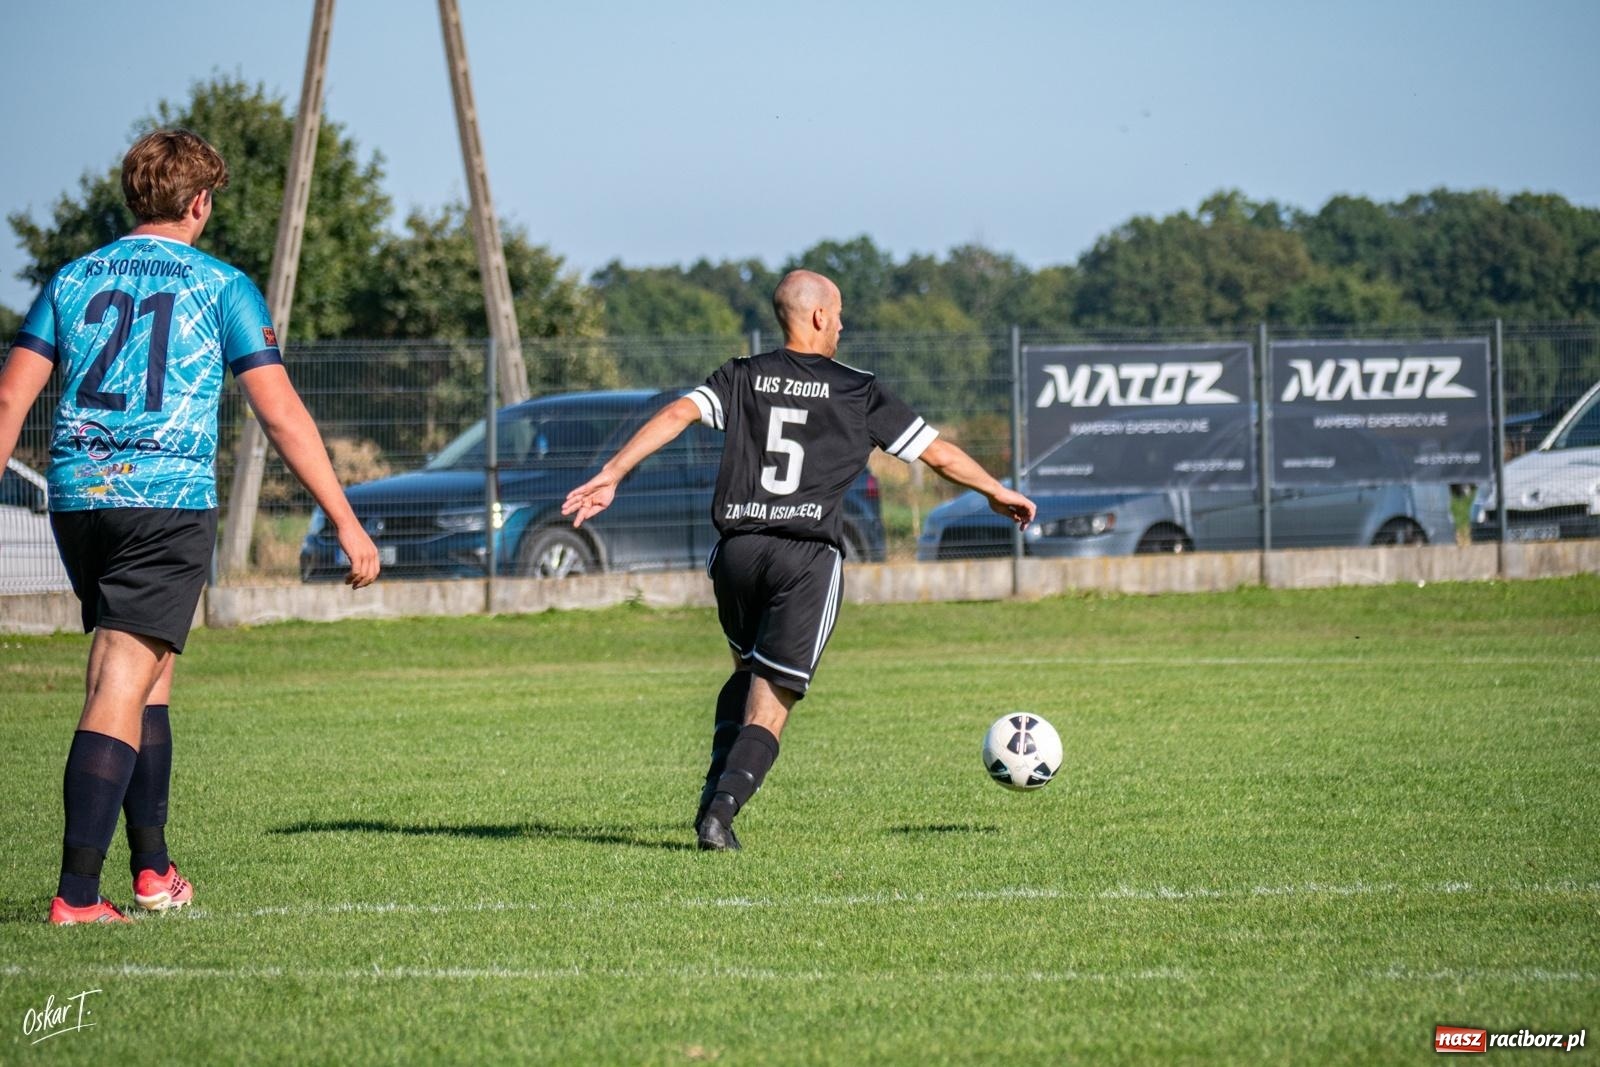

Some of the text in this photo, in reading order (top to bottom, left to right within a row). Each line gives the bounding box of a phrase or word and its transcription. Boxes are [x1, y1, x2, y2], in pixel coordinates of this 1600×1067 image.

[85, 259, 193, 279] KS KORNOWAC
[76, 290, 176, 412] 21
[754, 375, 830, 399] LKS ZGODA
[1036, 361, 1240, 408] MATOZ
[1281, 356, 1477, 402] MATOZ
[760, 406, 809, 496] 5
